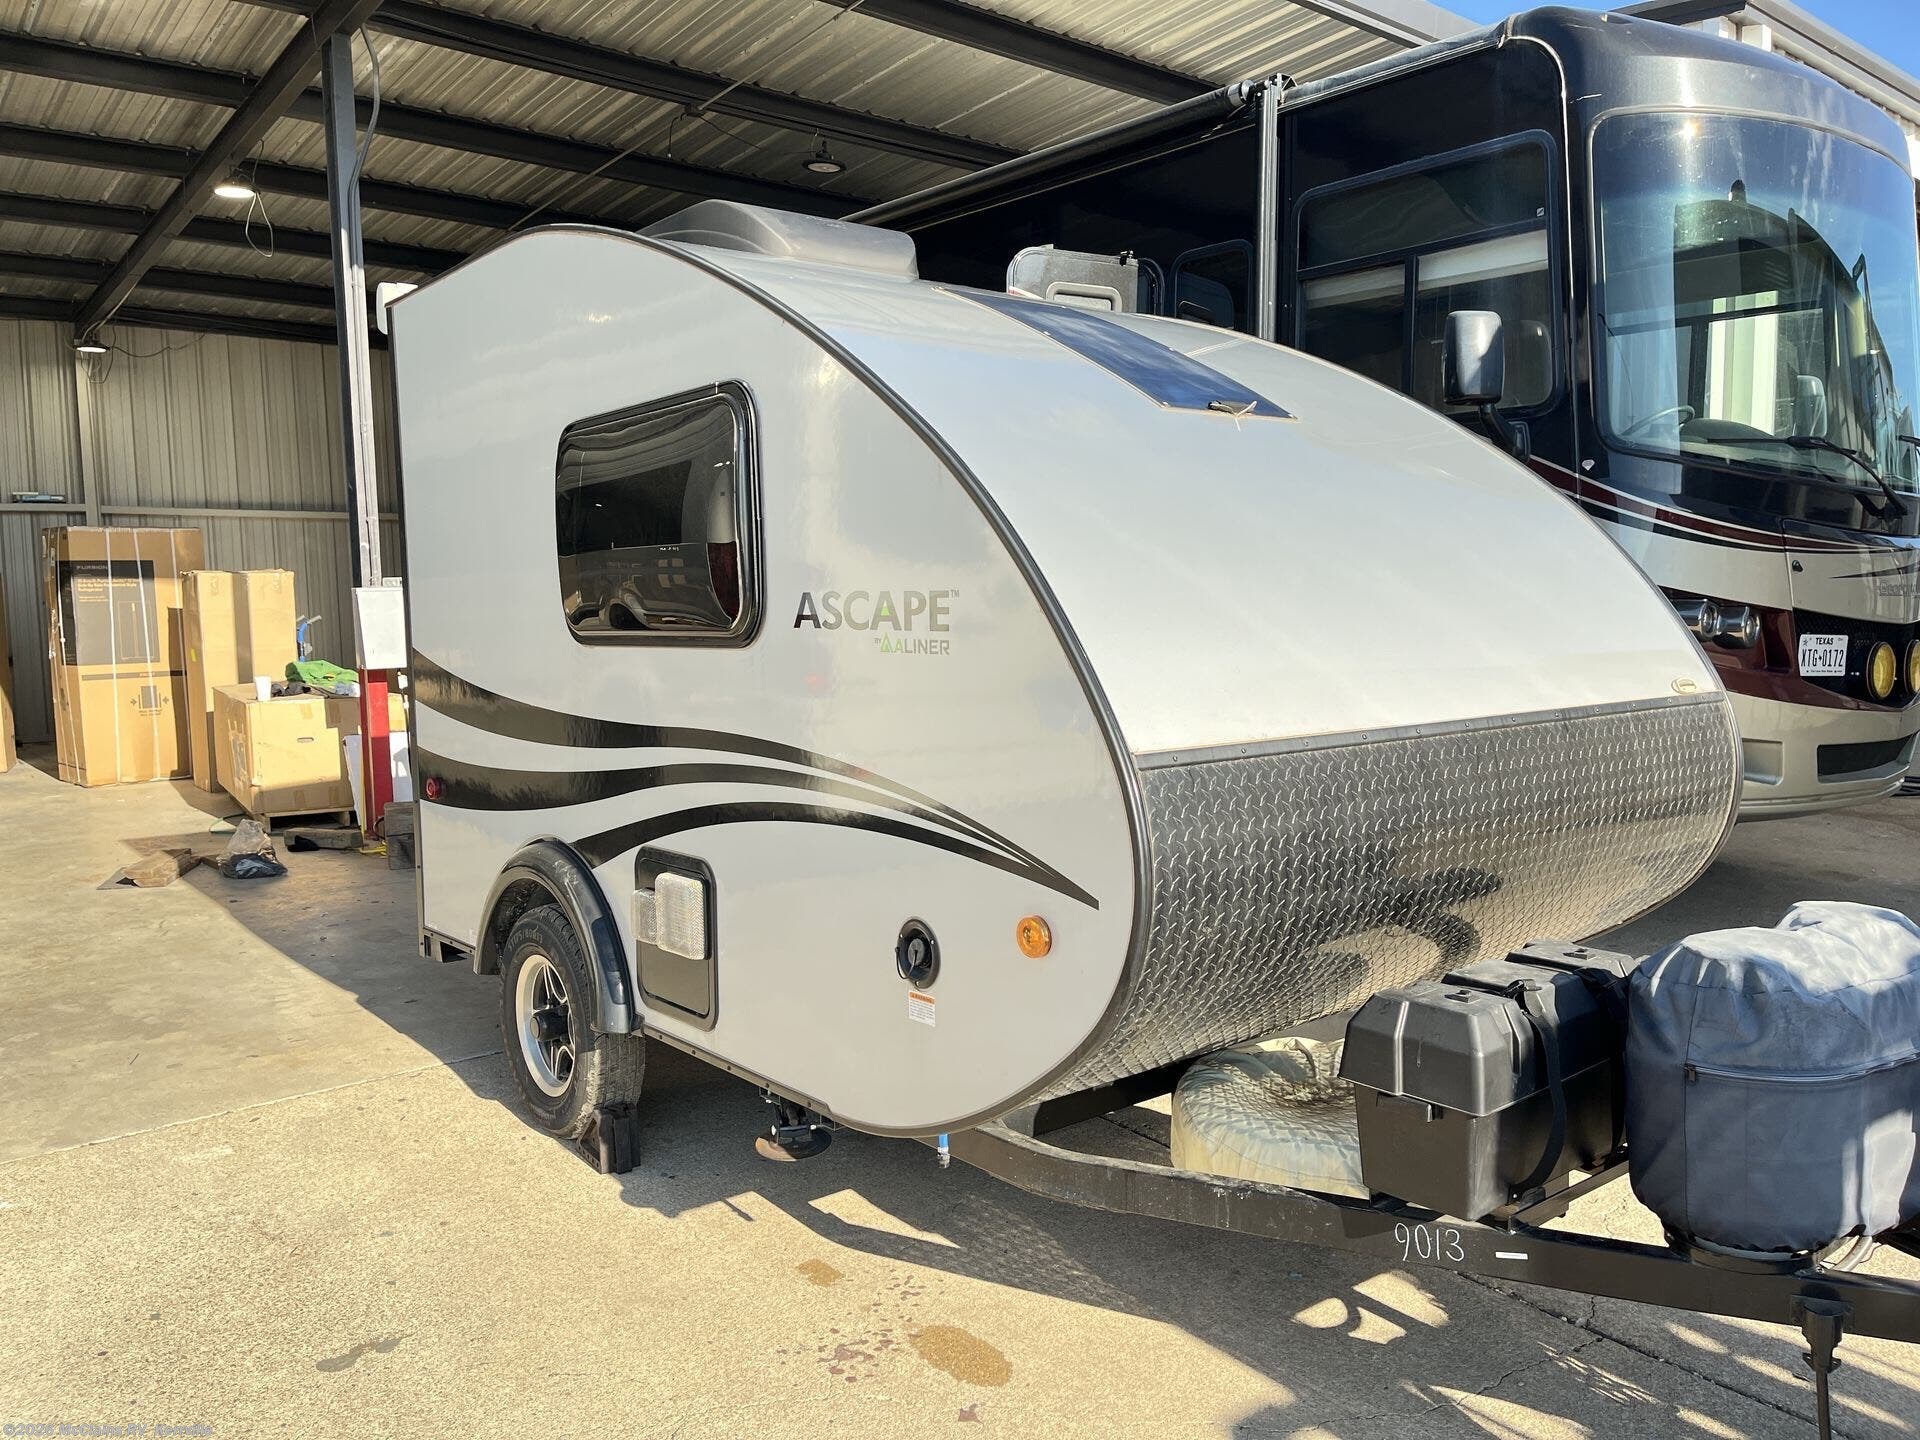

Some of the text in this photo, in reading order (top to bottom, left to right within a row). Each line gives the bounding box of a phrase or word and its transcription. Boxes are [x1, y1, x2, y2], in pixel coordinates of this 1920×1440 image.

[793, 590, 951, 632] ASCAPE
[1815, 637, 1834, 645] TEXAS
[1395, 1223, 1464, 1261] 9013
